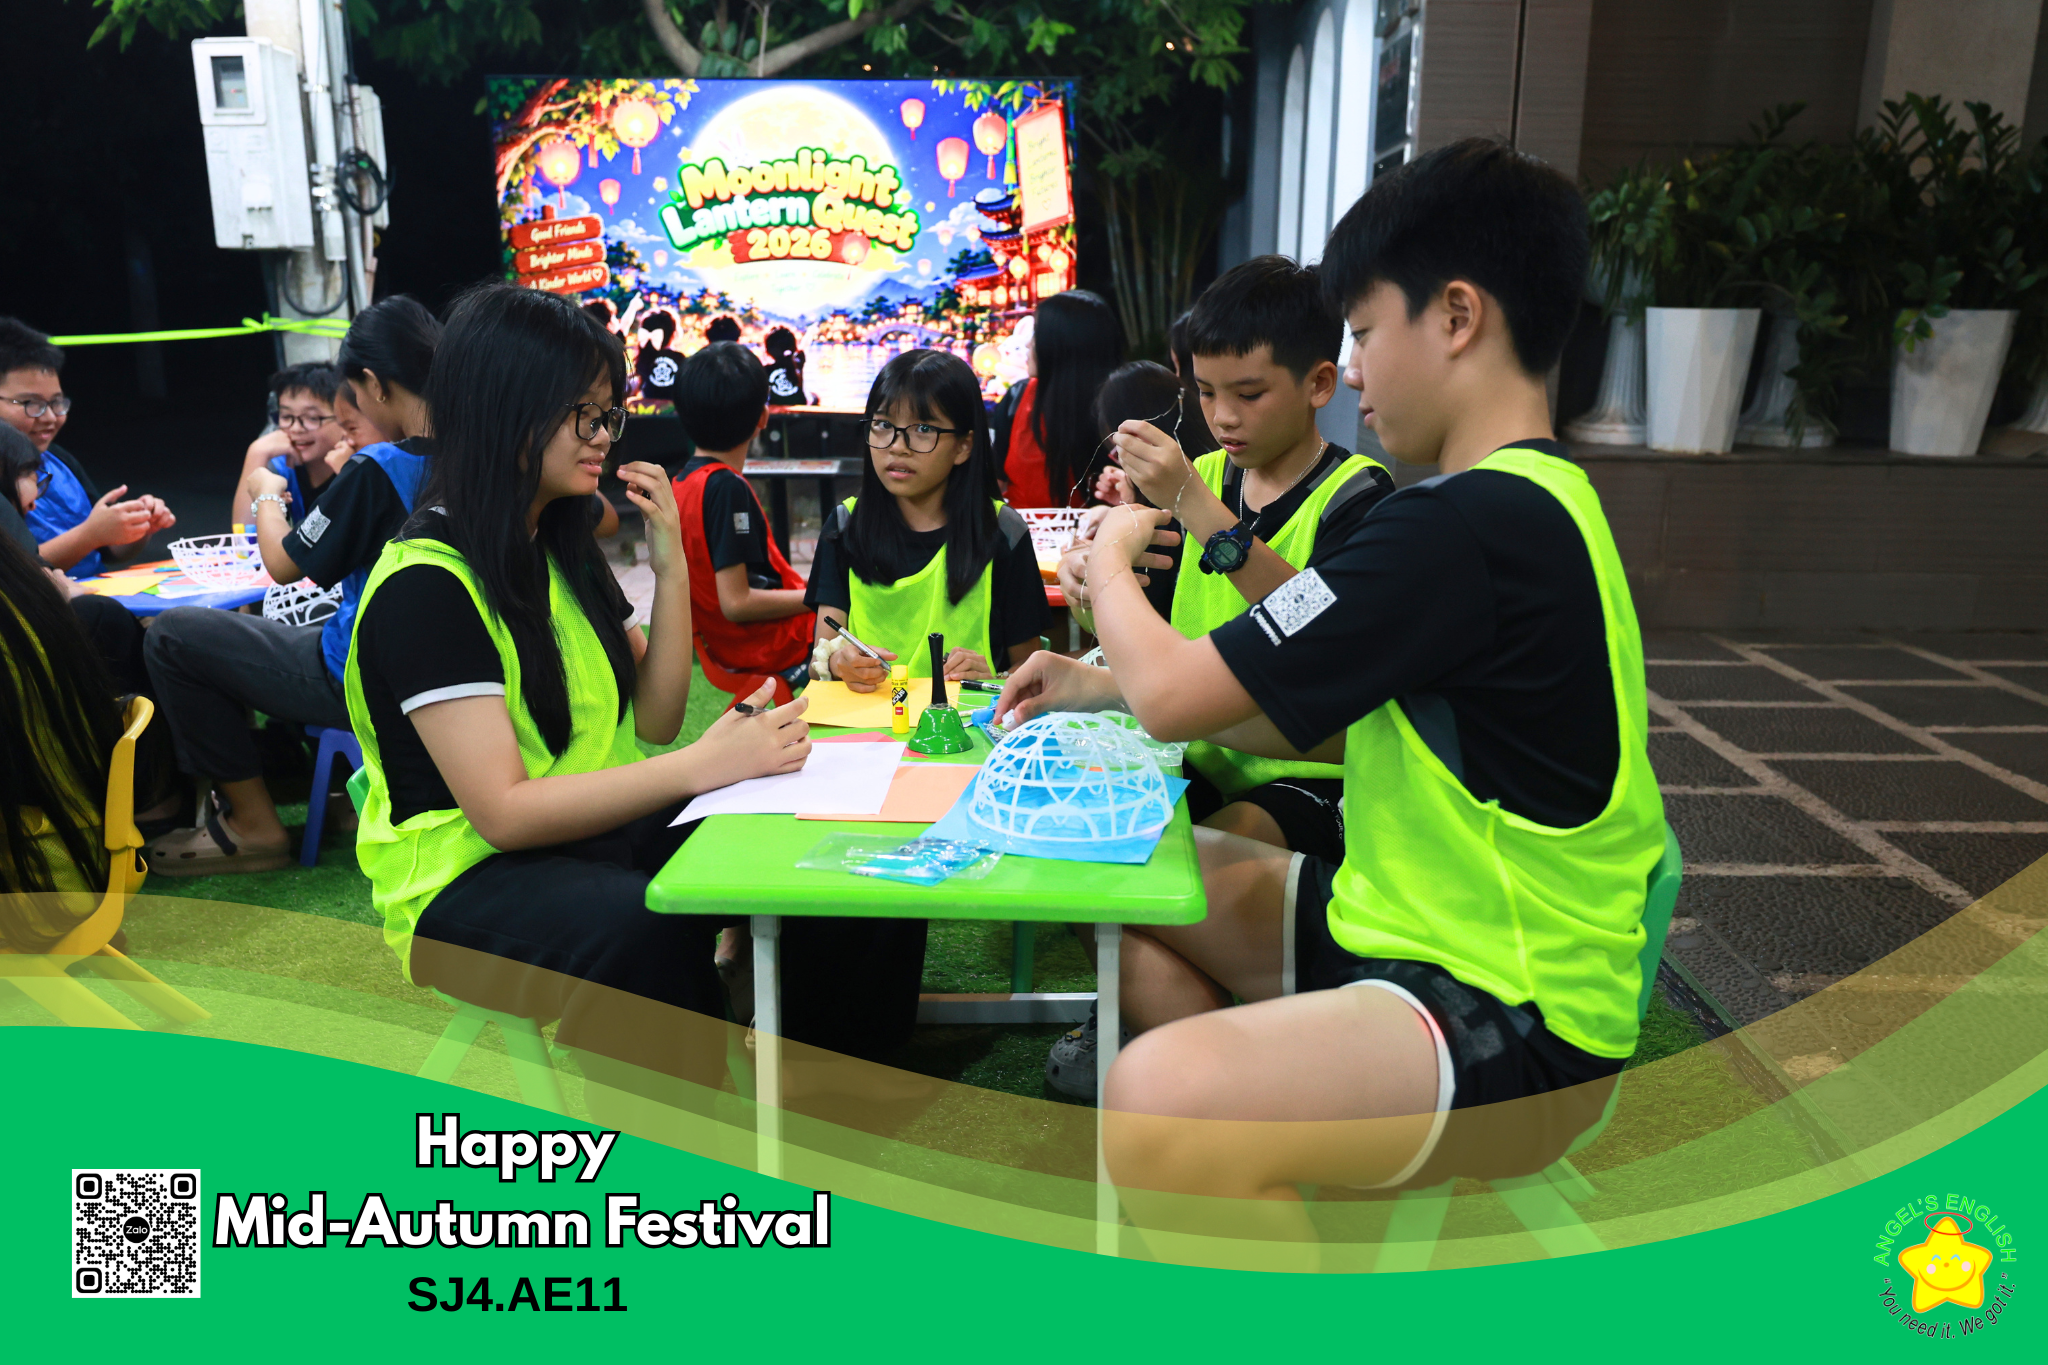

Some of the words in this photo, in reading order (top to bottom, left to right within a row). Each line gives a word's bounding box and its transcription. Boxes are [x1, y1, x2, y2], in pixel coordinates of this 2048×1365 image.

[680, 147, 900, 209] Moonlight
[530, 225, 553, 243] Good
[554, 220, 587, 238] Friends
[660, 194, 811, 249] Lantern
[811, 190, 920, 251] Quest
[529, 251, 566, 270] Brighter
[567, 245, 594, 261] Minds
[746, 228, 833, 260] 2026
[539, 275, 566, 290] Kinder
[567, 269, 593, 286] World
